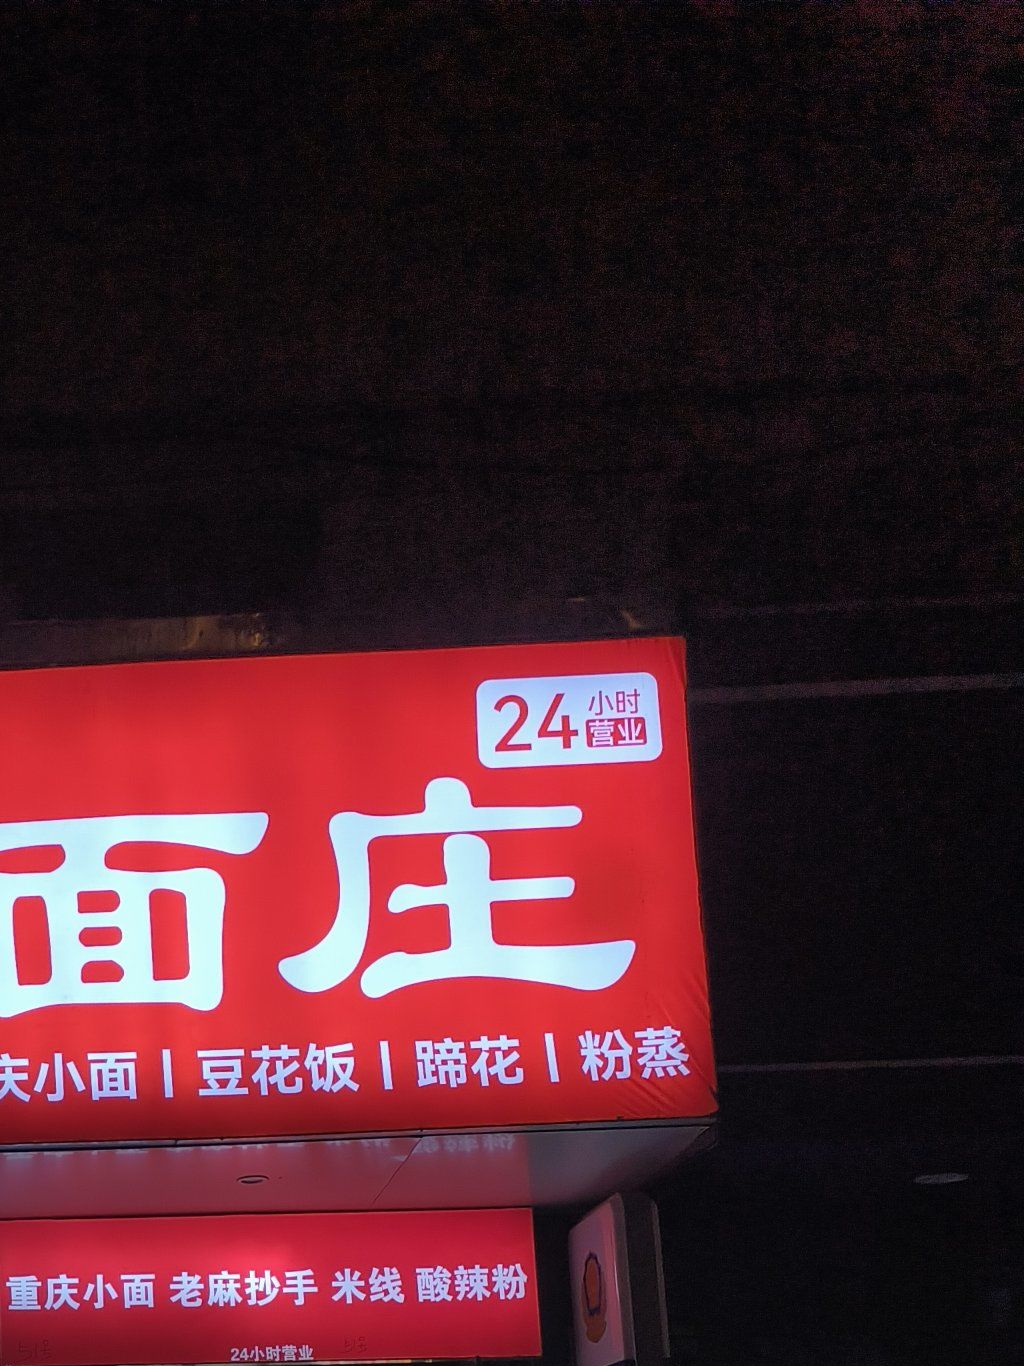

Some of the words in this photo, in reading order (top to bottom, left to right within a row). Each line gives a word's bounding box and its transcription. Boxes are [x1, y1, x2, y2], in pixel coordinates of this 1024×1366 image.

[588, 688, 642, 716] 小时
[492, 692, 579, 753] 24
[588, 717, 645, 747] 营业
[197, 1041, 360, 1098] 豆花饭
[416, 1034, 525, 1090] 蹄花
[579, 1025, 691, 1082] 粉蒸
[5, 1272, 156, 1311] 重庆小面
[170, 1268, 319, 1307] 老麻抄手
[331, 1267, 405, 1304] 米线
[417, 1263, 528, 1302] 酸辣粉
[230, 1344, 314, 1362] 24小时营业
